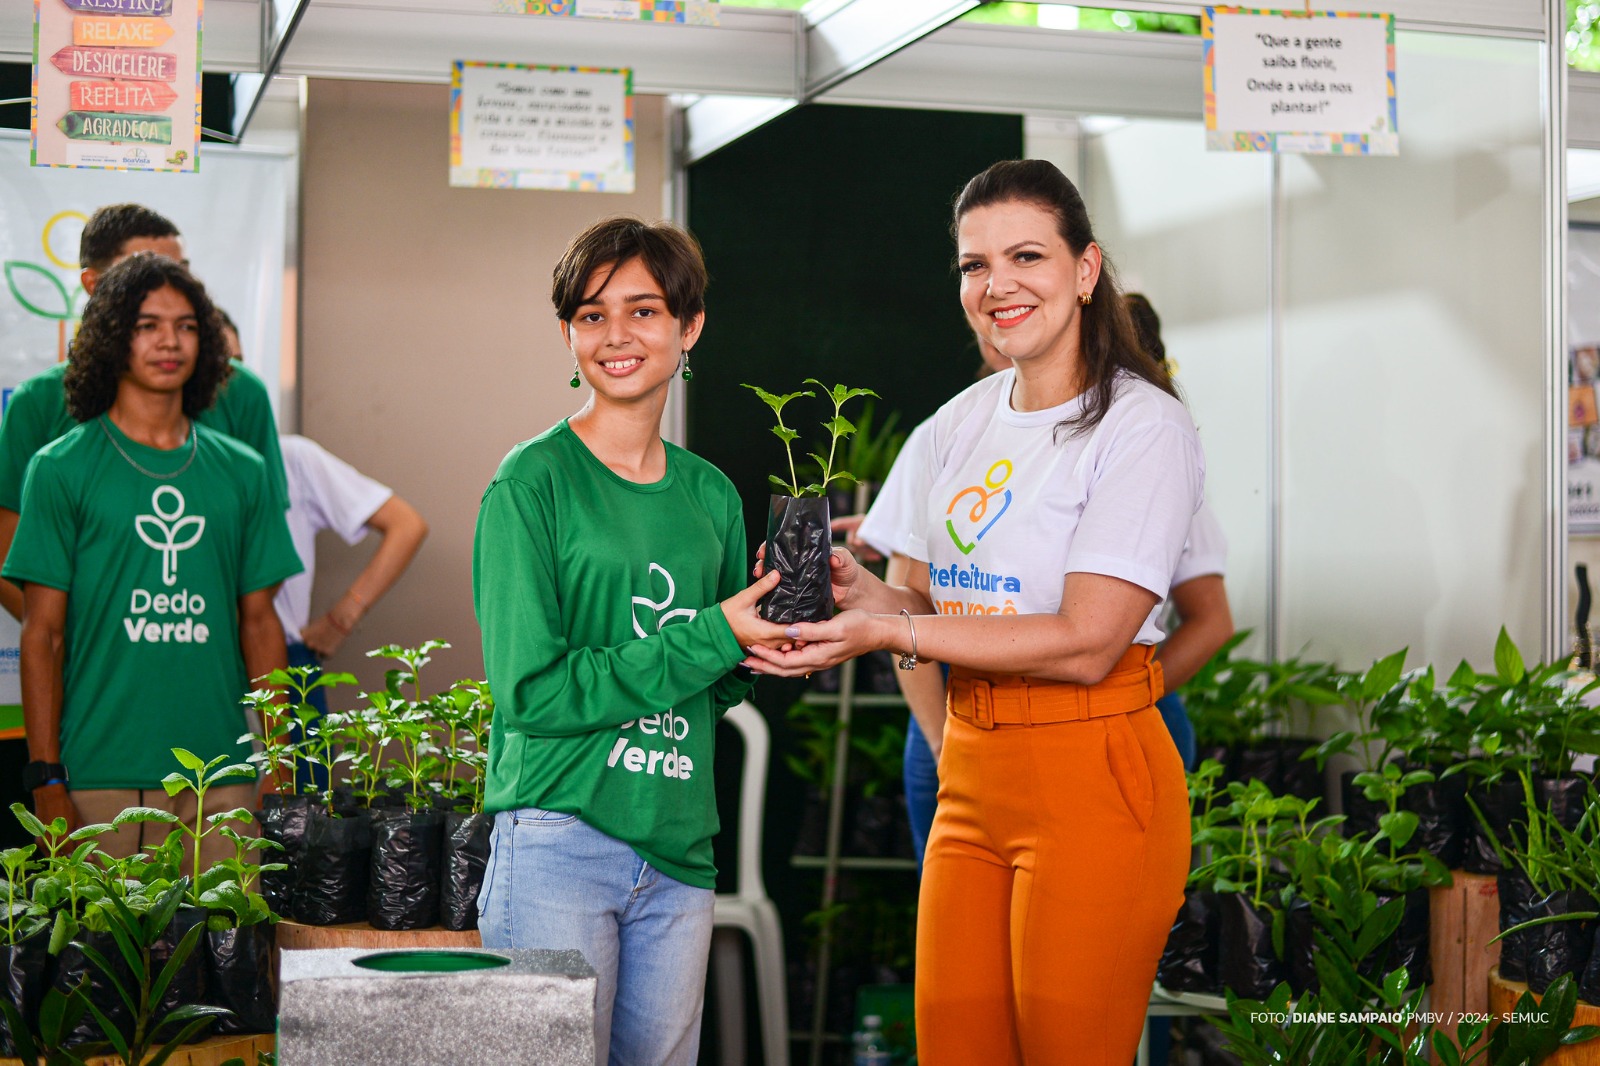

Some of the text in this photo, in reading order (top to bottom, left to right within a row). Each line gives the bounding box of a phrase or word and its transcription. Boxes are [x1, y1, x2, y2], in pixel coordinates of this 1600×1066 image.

[82, 22, 154, 40] RELAXE
[1294, 37, 1302, 47] a
[1305, 36, 1342, 51] gente
[73, 51, 167, 79] DESACELERE
[1262, 56, 1297, 69] saiba
[80, 87, 155, 107] REFLITA
[1247, 78, 1353, 94] Onde a vida nos
[82, 117, 159, 142] AGRADEÇA
[130, 588, 206, 615] Dedo
[123, 617, 210, 644] Verde
[620, 707, 690, 741] edo
[607, 737, 694, 781] Verde
